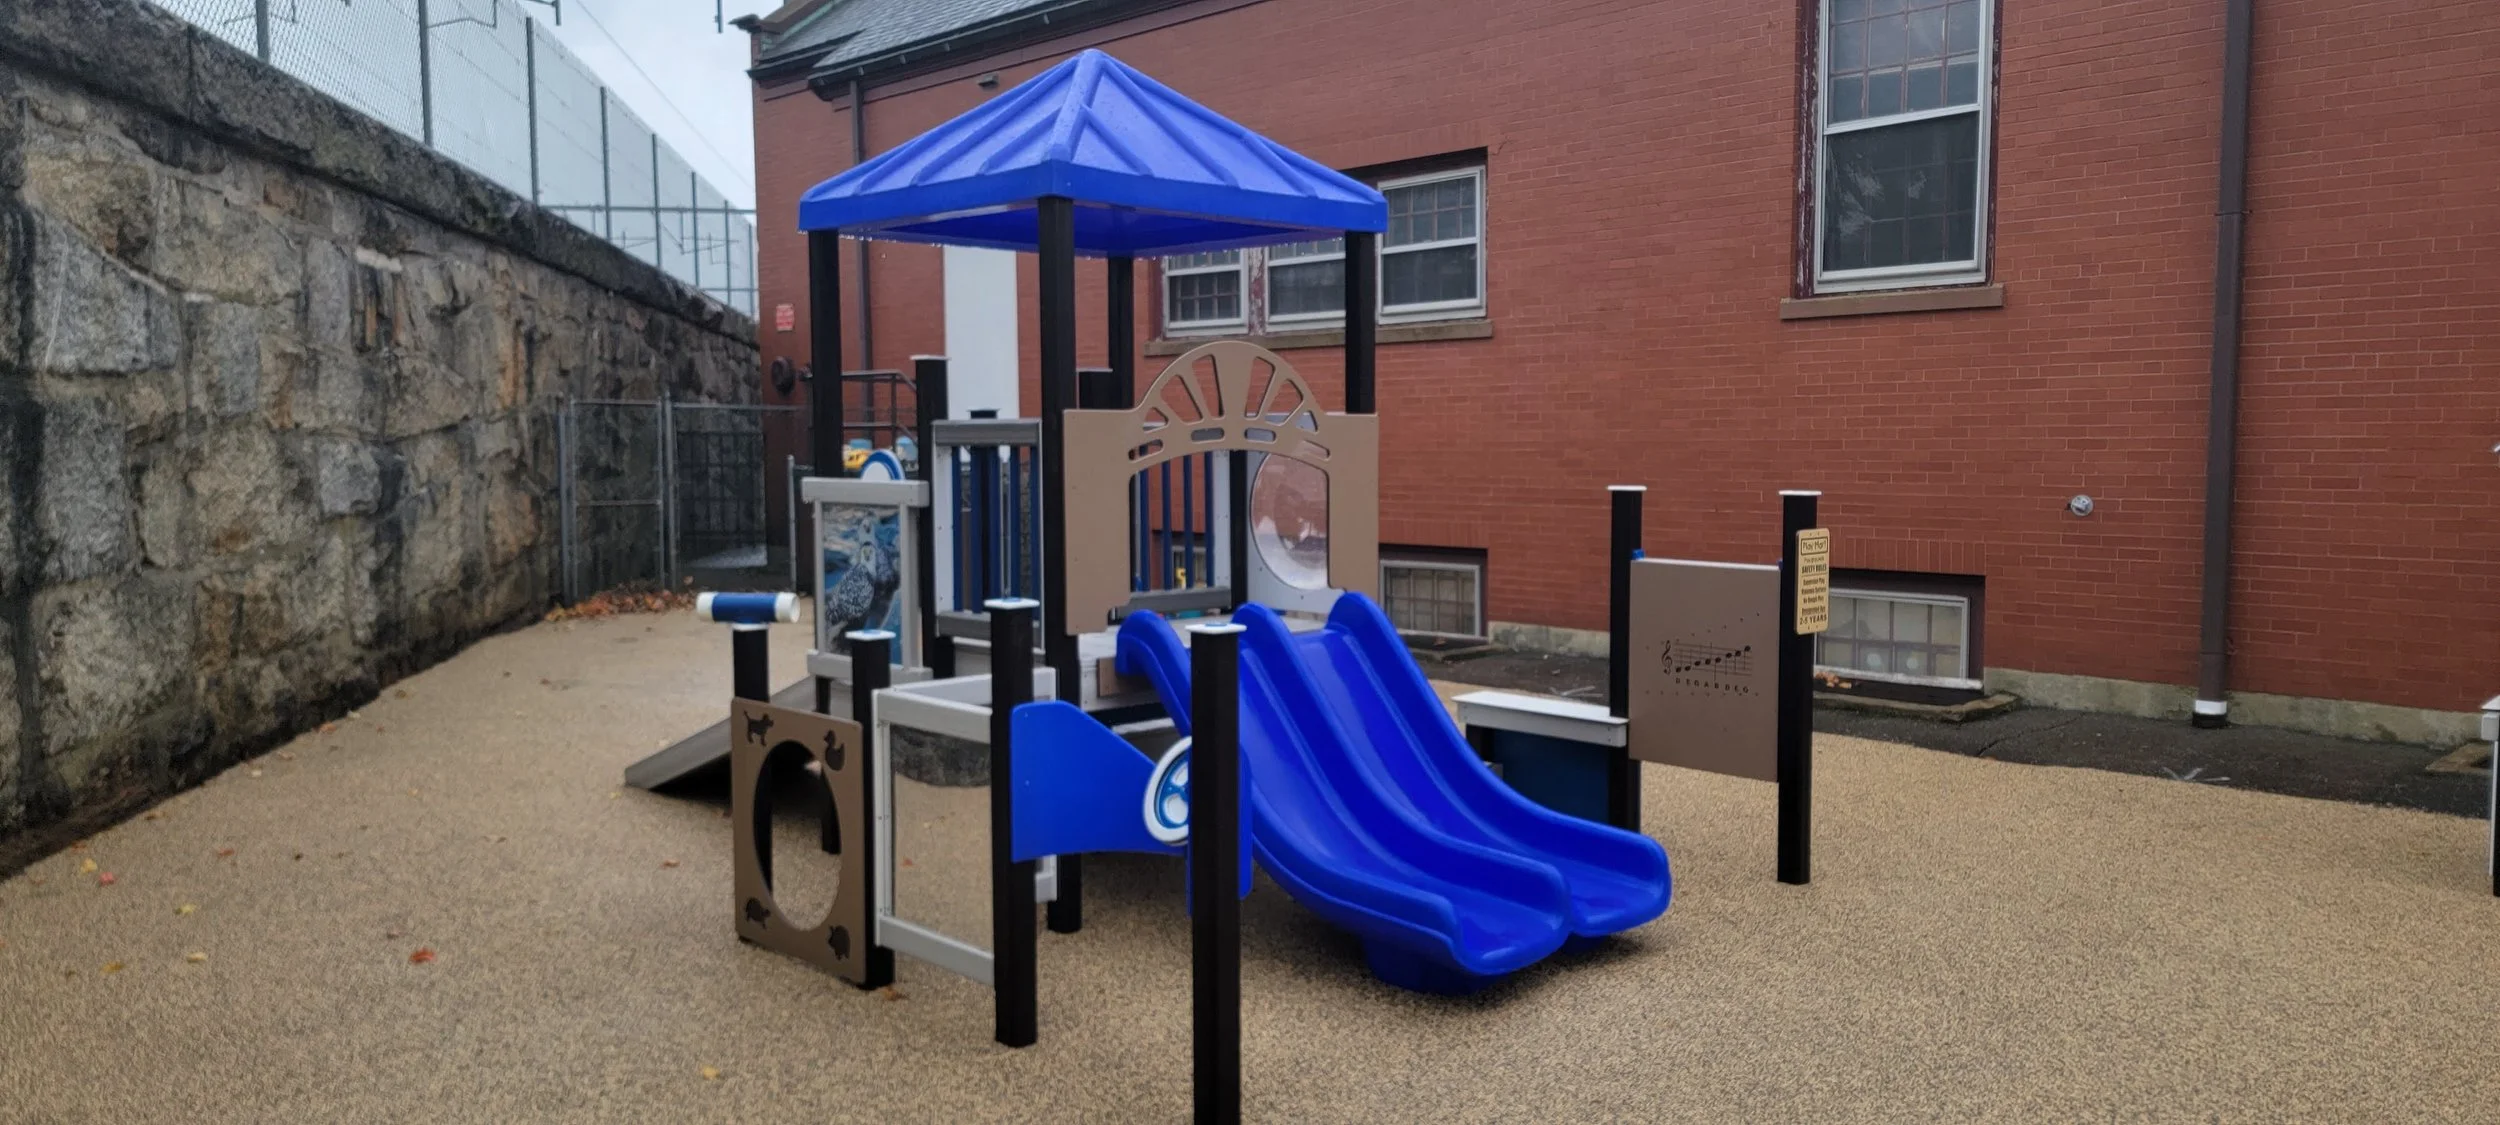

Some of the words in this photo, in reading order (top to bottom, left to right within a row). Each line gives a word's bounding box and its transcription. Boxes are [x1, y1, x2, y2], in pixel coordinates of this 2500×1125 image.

[1803, 541, 1813, 551] Play
[1802, 565, 1815, 574] SAFETY
[1815, 563, 1827, 572] RULES
[1800, 616, 1808, 625] 2-5
[1809, 613, 1827, 624] YEARS
